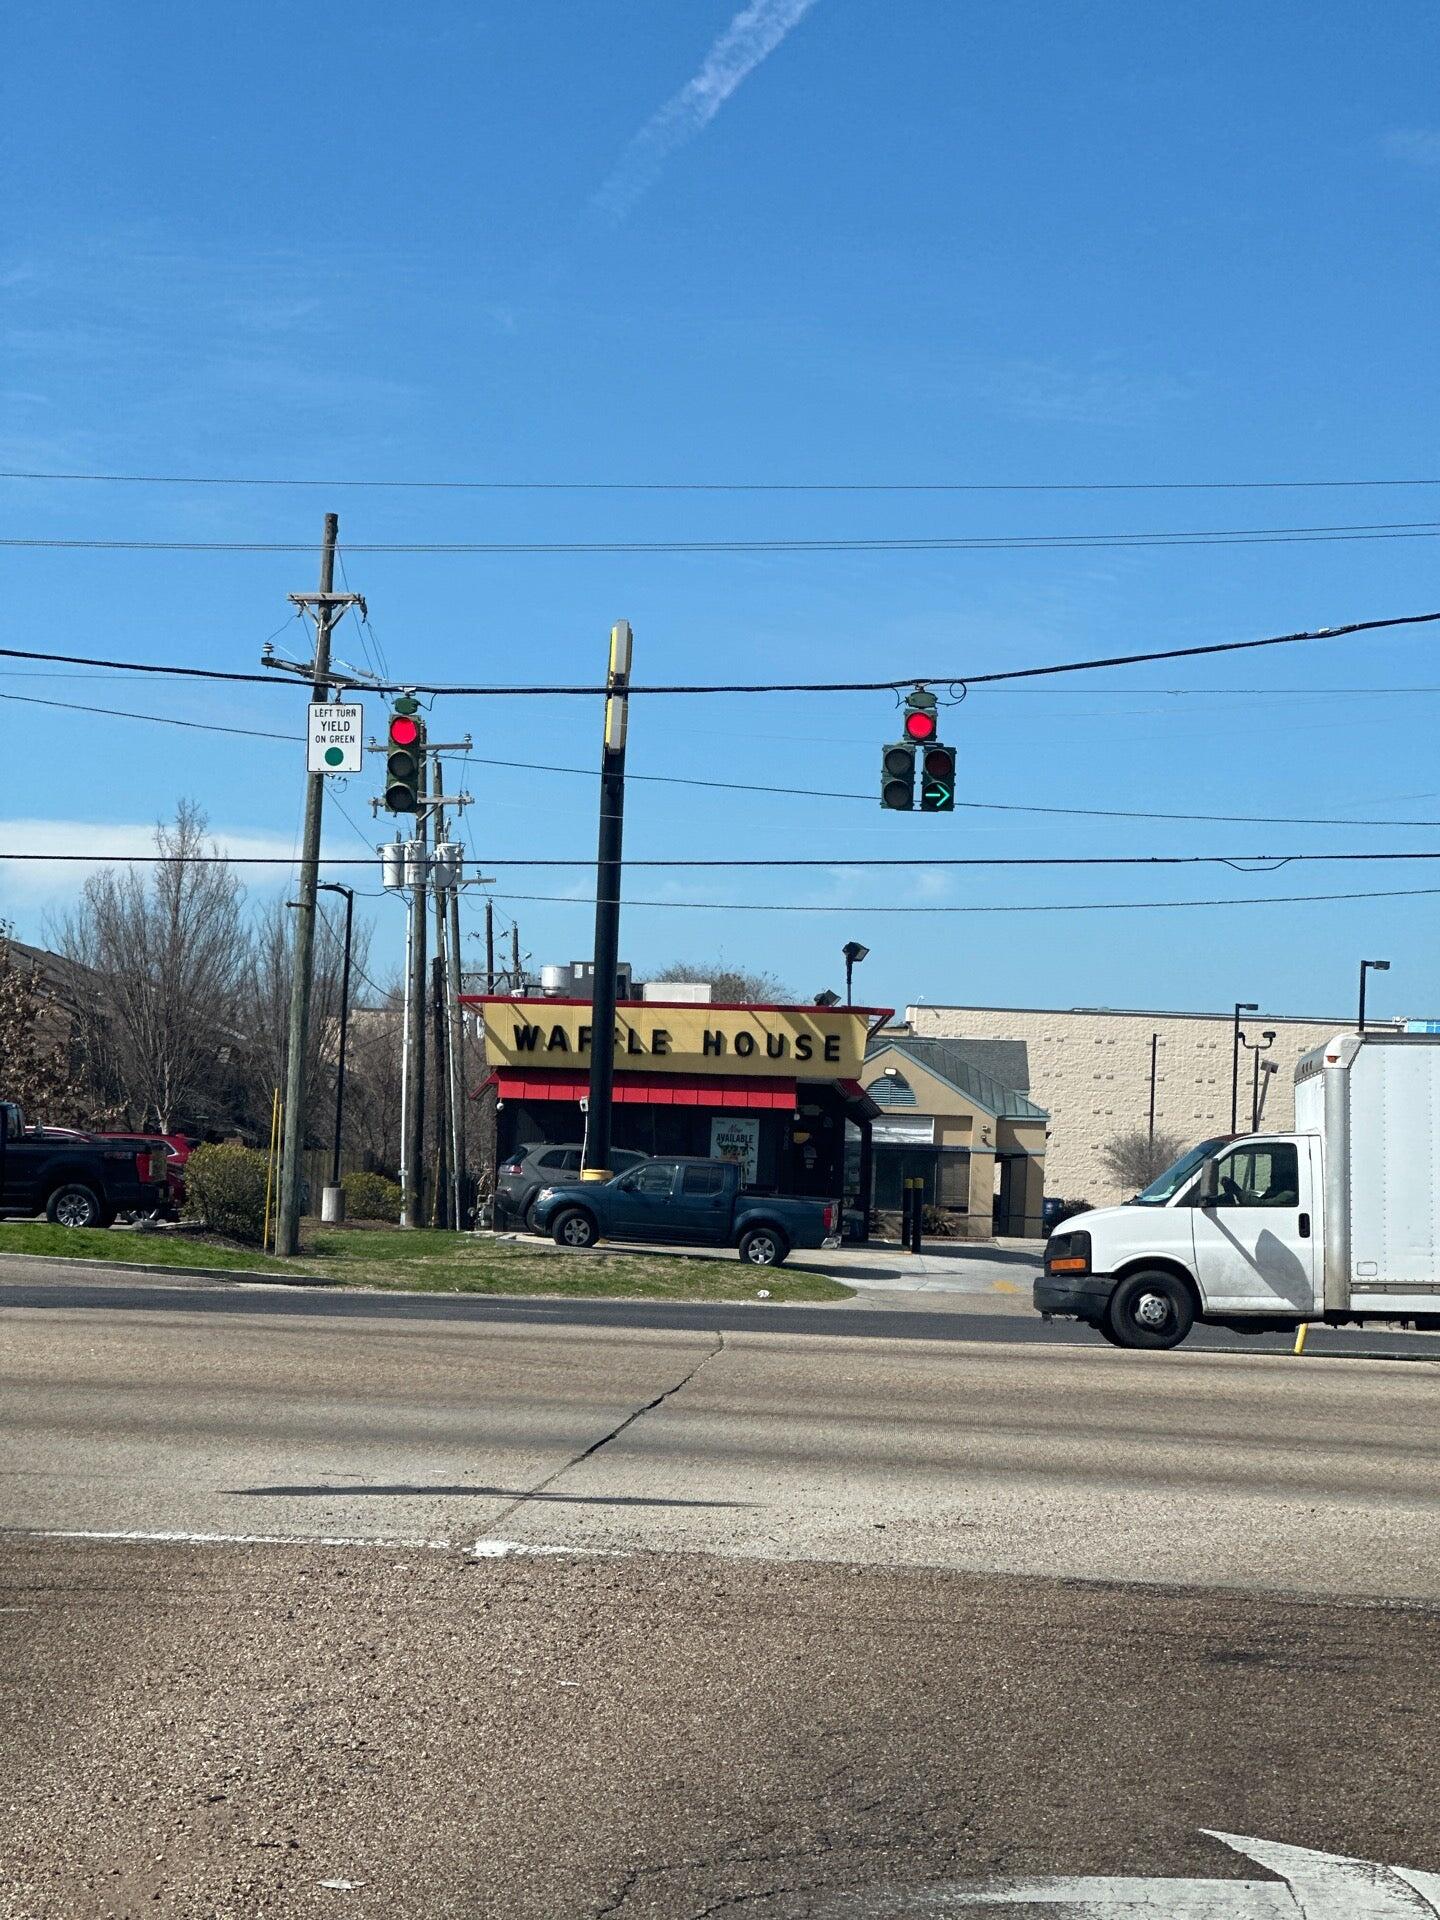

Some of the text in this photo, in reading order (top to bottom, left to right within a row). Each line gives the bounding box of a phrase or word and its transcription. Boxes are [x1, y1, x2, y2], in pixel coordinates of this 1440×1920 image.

[314, 708, 356, 718] LEFT TURN
[321, 720, 351, 732] YIELD
[315, 735, 355, 744] ON GREEN
[512, 1024, 841, 1062] WAFLE HOUSE
[716, 1133, 754, 1143] AVAILABLE
